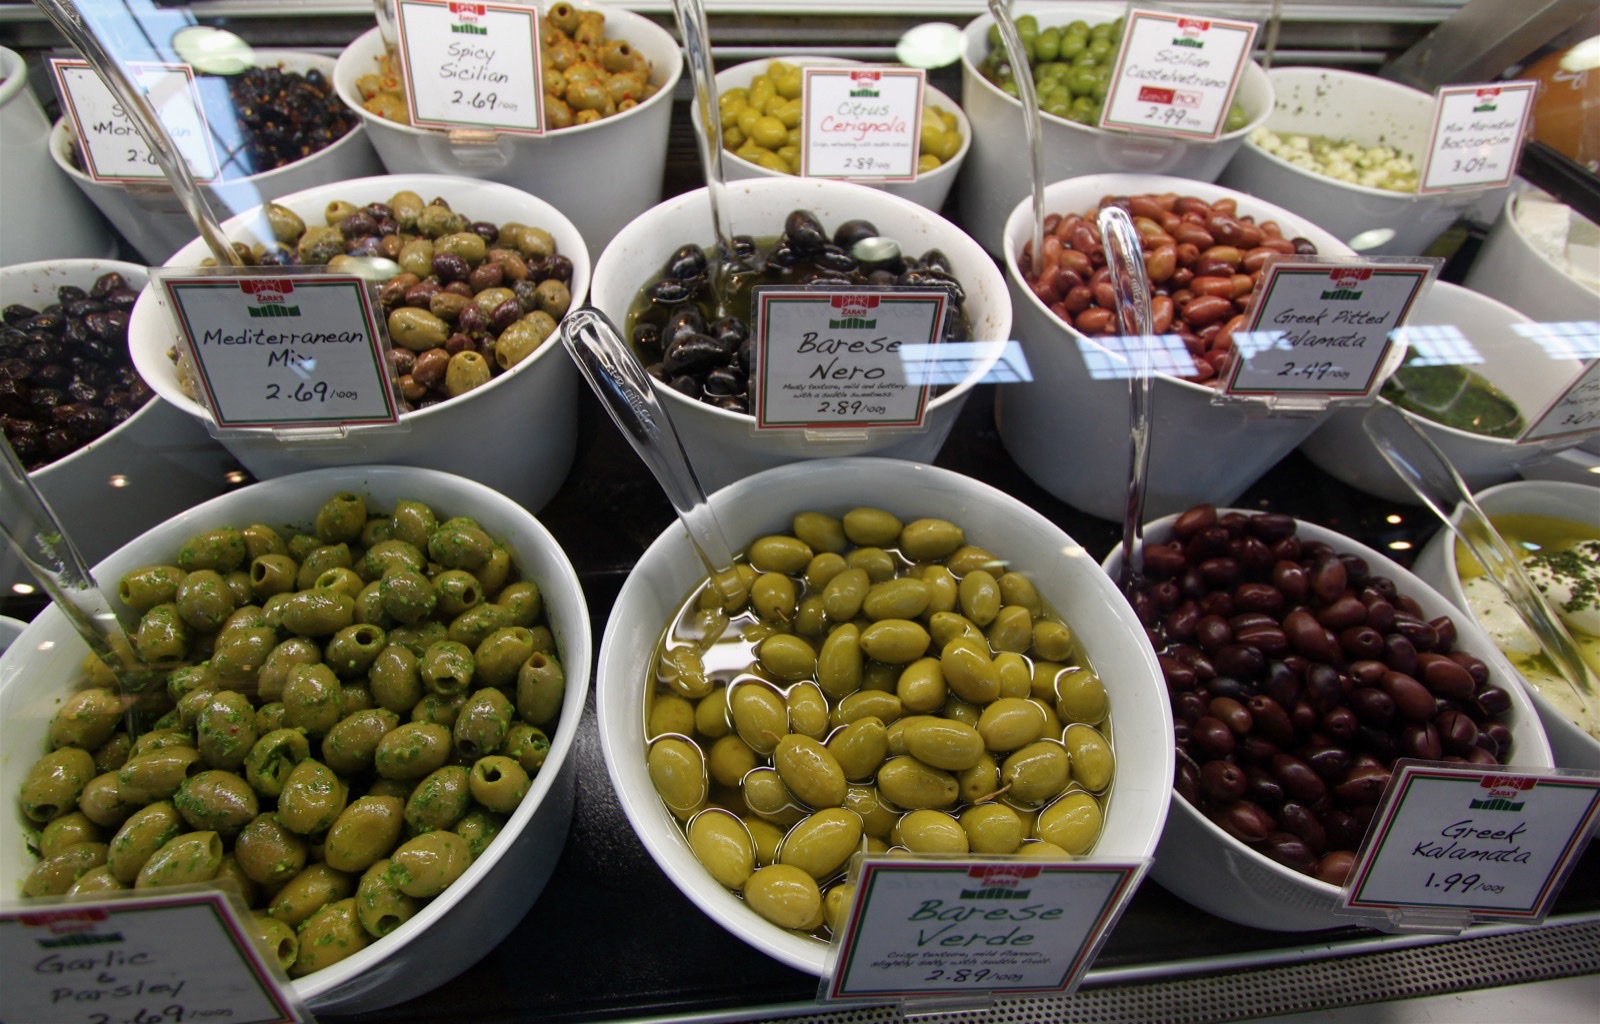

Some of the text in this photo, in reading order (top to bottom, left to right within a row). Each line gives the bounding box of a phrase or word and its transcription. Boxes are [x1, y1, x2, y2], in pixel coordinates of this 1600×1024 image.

[448, 42, 495, 65] Spicy
[440, 63, 509, 83] Sicilian
[838, 101, 890, 117] Citrus
[820, 115, 906, 141] Cerignola
[1273, 308, 1390, 326] Greek Pitted
[203, 328, 363, 346] Mediterranean
[797, 331, 903, 354] Barese
[809, 357, 885, 380] Nero
[265, 381, 358, 402] 2.69/100g
[793, 390, 812, 398] with
[817, 400, 886, 415] 2.89/100g
[1441, 819, 1526, 843] Greek
[1412, 841, 1531, 864] Kalamata
[908, 900, 1064, 922] Barese
[916, 926, 1035, 947] Verde
[33, 951, 156, 973] Garlic
[924, 969, 1024, 982] 2.89/100g
[50, 980, 186, 1003] Parsley
